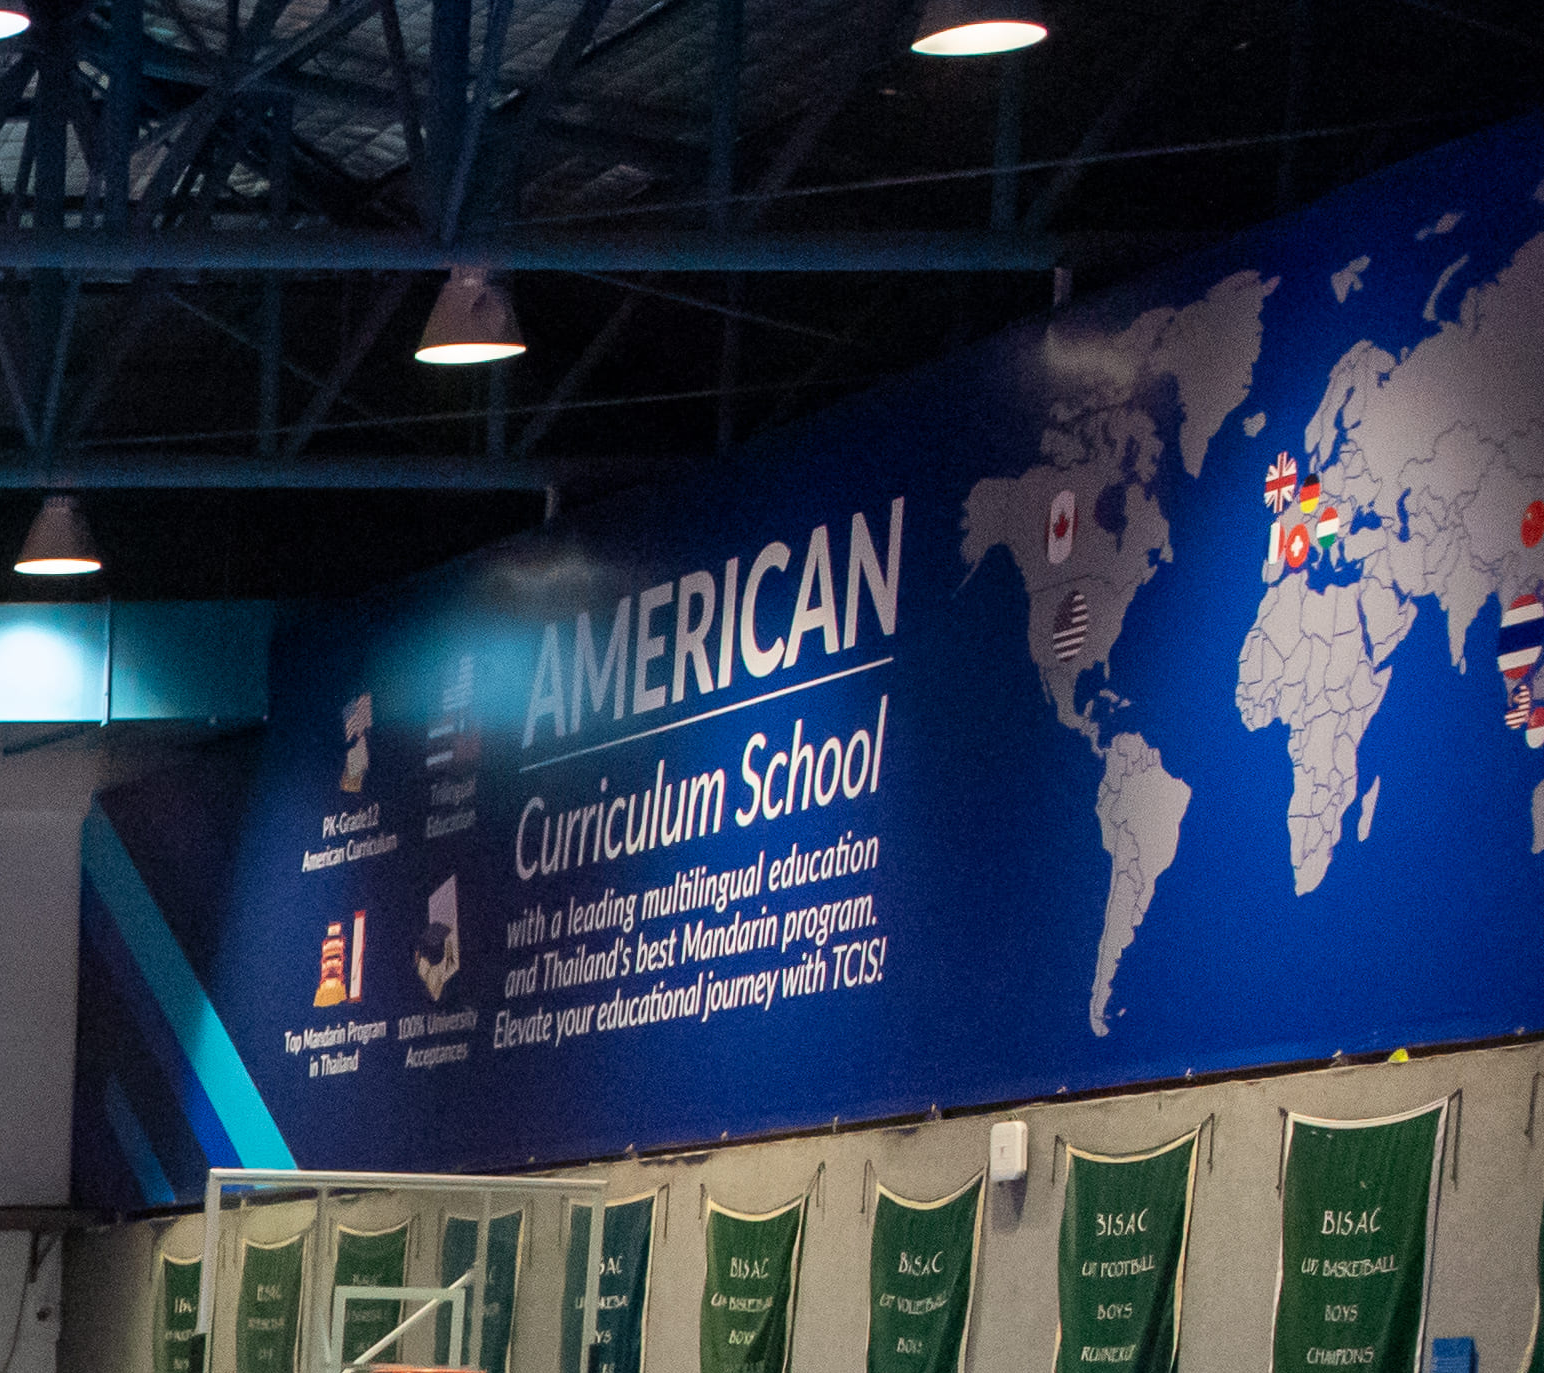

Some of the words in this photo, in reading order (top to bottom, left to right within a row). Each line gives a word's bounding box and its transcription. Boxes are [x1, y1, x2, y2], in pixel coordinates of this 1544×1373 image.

[521, 496, 905, 750] AMERICAN
[514, 759, 726, 881] Curriculum
[734, 694, 889, 827] School
[302, 845, 346, 873] American
[346, 833, 398, 861] Curriculum
[507, 908, 546, 949] with
[550, 912, 561, 939] a
[567, 888, 637, 937] leading
[641, 851, 766, 921] multilingual
[768, 830, 880, 891] education
[504, 958, 539, 1000] and
[542, 936, 632, 991] Thailand's
[635, 932, 678, 974] best
[680, 906, 779, 965] Mandarin
[781, 894, 878, 953] program.
[493, 1006, 551, 1050] Elevate
[555, 1005, 596, 1048] your
[596, 971, 703, 1033] educational
[701, 969, 779, 1023] journey
[782, 951, 826, 998] with
[832, 936, 888, 990] TCIS!
[284, 1030, 303, 1056] Top
[302, 1023, 347, 1051] Mandarin
[347, 1020, 388, 1046] Program
[397, 1016, 426, 1041] 100%
[427, 1006, 479, 1036] University
[309, 1056, 318, 1078] in
[320, 1049, 360, 1076] Thailand
[1320, 1206, 1383, 1237] BISAC
[729, 1257, 770, 1279] BISAC
[898, 1251, 944, 1277] BISAC
[1100, 1254, 1156, 1279] FOOTBALL
[1321, 1253, 1400, 1279] BASKETBALL
[1097, 1302, 1133, 1321] BOYS
[1323, 1303, 1360, 1323] BOYS
[1306, 1345, 1375, 1368] CHAMPIONS
